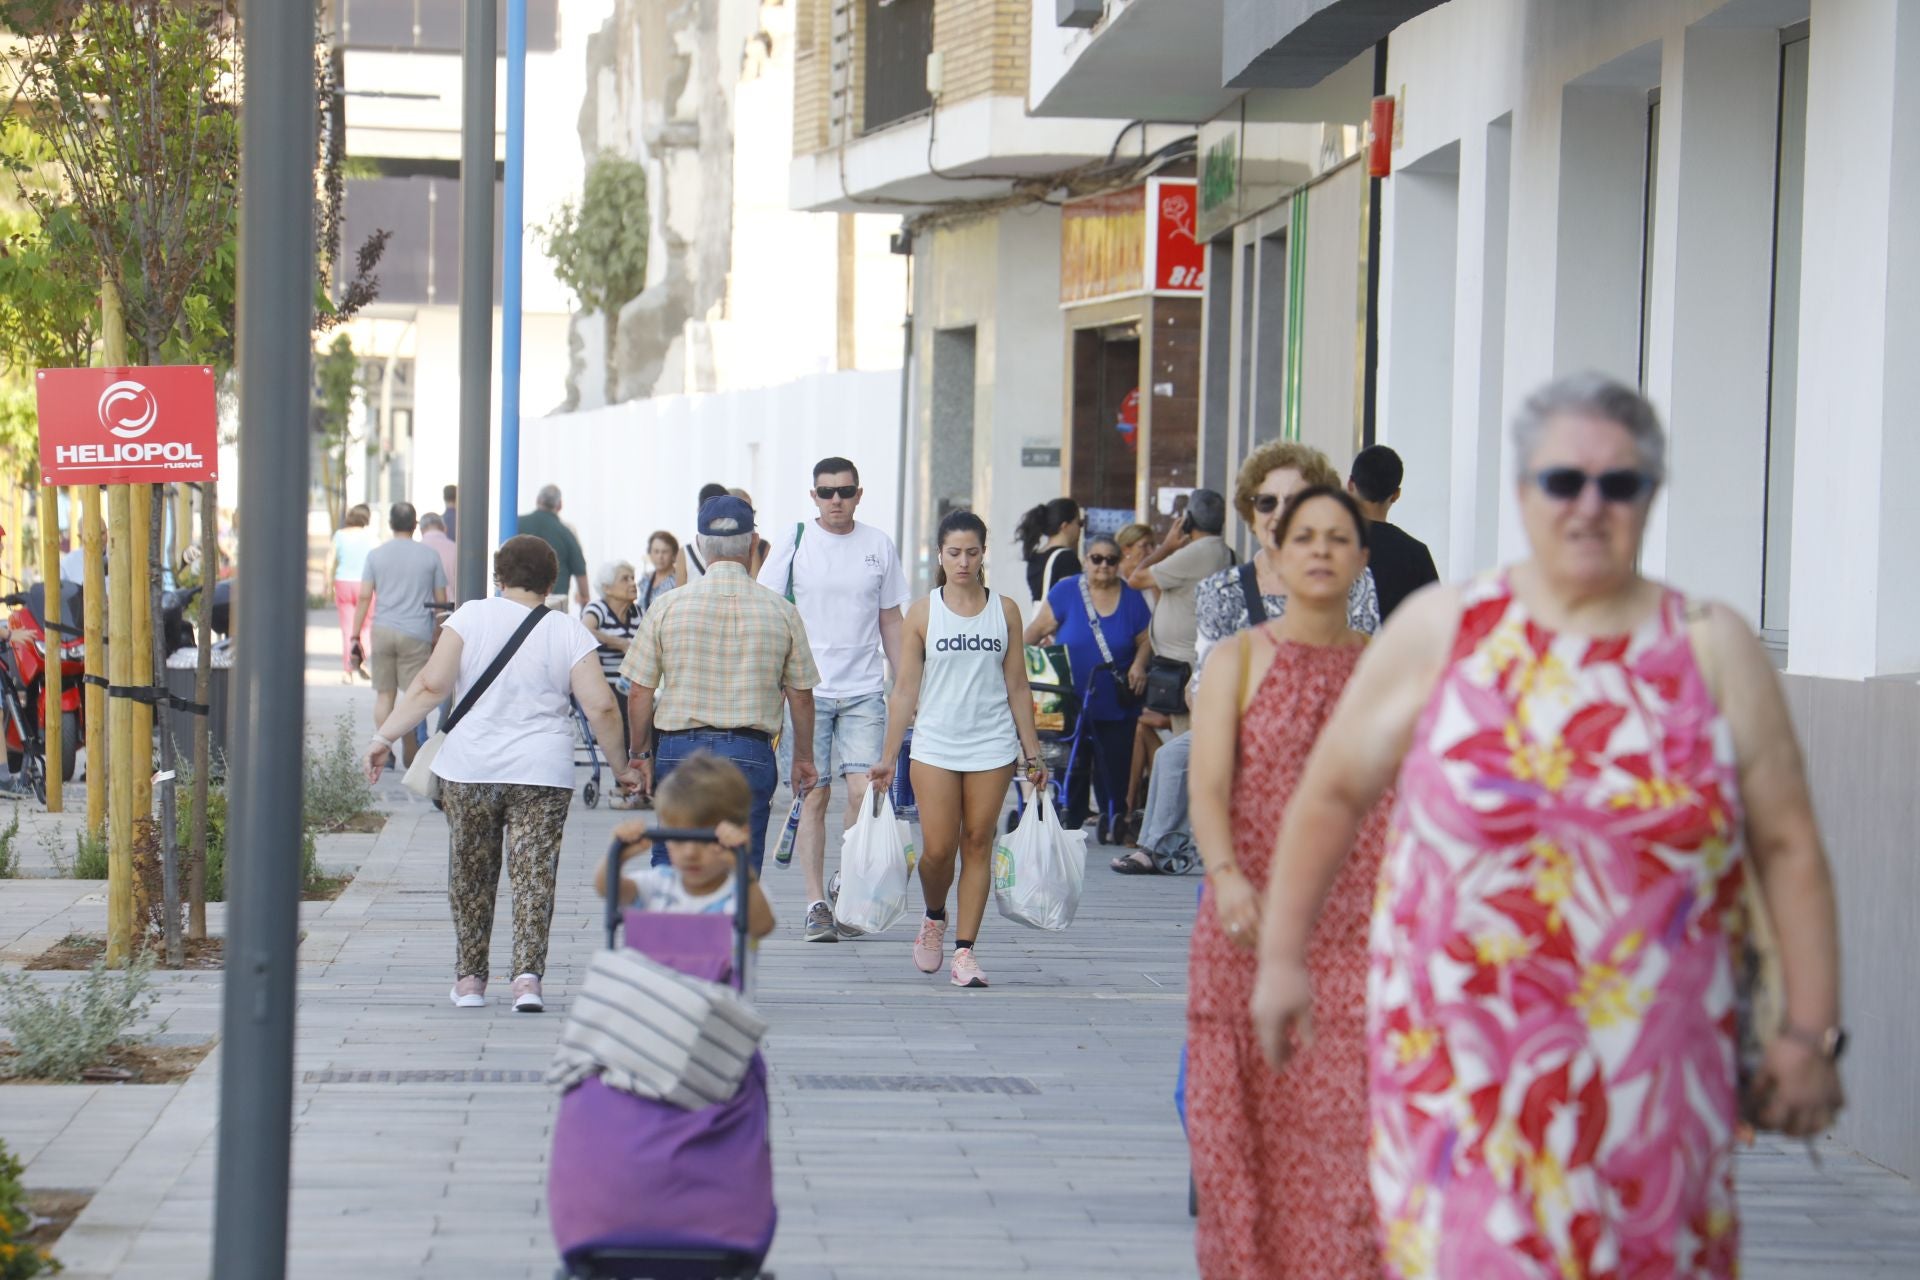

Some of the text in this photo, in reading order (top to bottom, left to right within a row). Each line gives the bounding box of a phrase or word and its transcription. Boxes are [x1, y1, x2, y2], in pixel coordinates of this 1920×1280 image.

[56, 442, 203, 463] HELIOPOL
[163, 460, 203, 469] rusvel
[936, 634, 1002, 652] adidas
